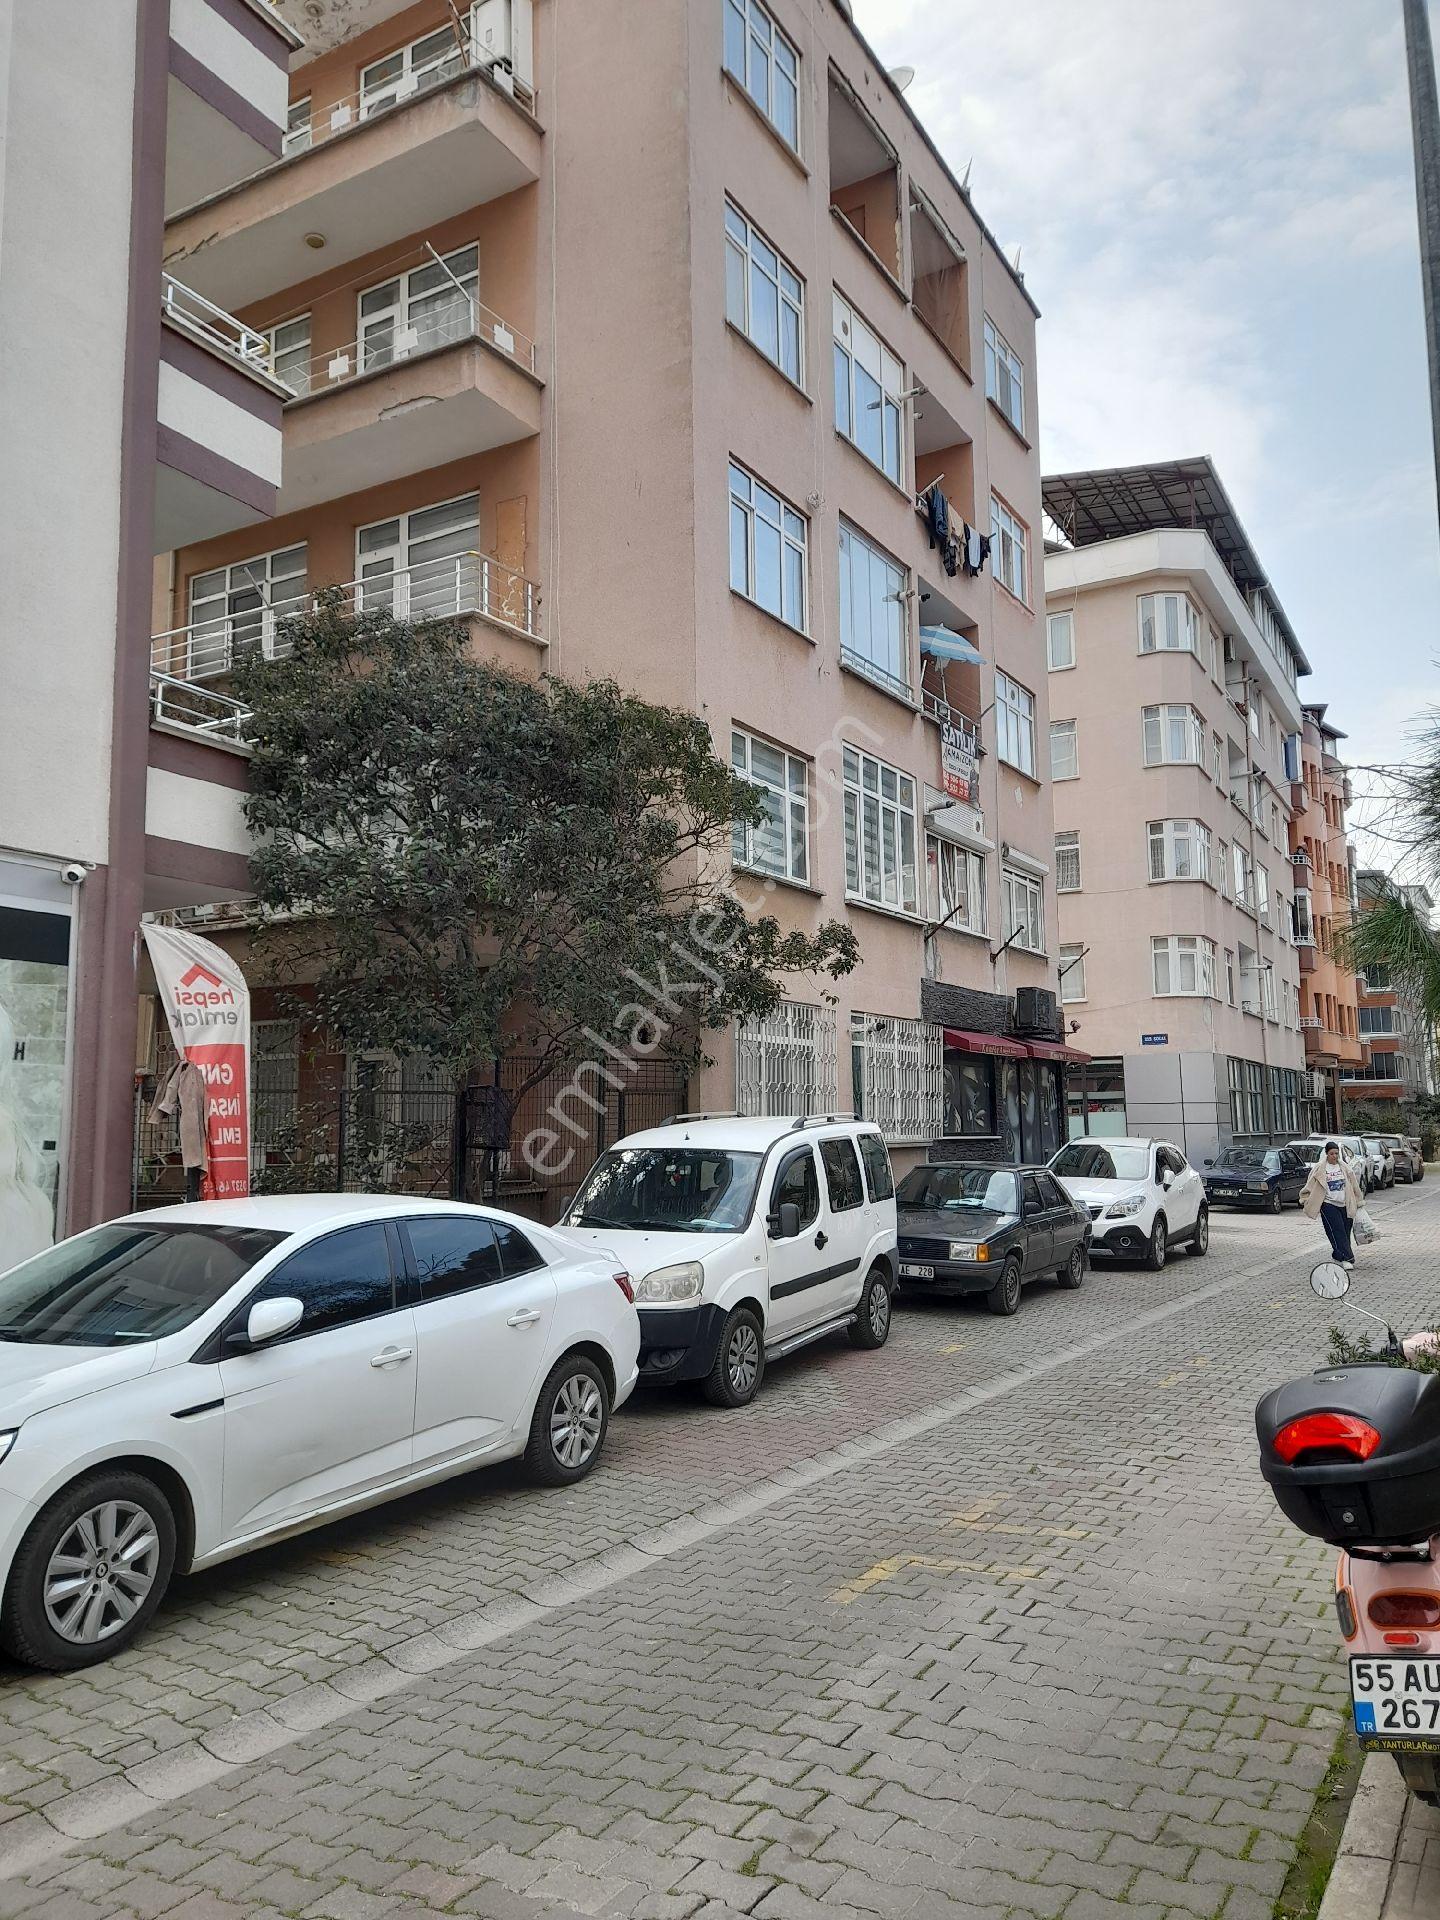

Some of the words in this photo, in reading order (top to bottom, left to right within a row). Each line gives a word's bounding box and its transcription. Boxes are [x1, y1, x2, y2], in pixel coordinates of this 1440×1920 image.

[942, 722, 976, 757] SATILIK
[918, 1266, 933, 1277] 228
[1356, 1664, 1394, 1692] 55
[1361, 1721, 1374, 1732] TR
[1381, 1698, 1440, 1729] 267
[1381, 1740, 1429, 1750] YANTURLAR
